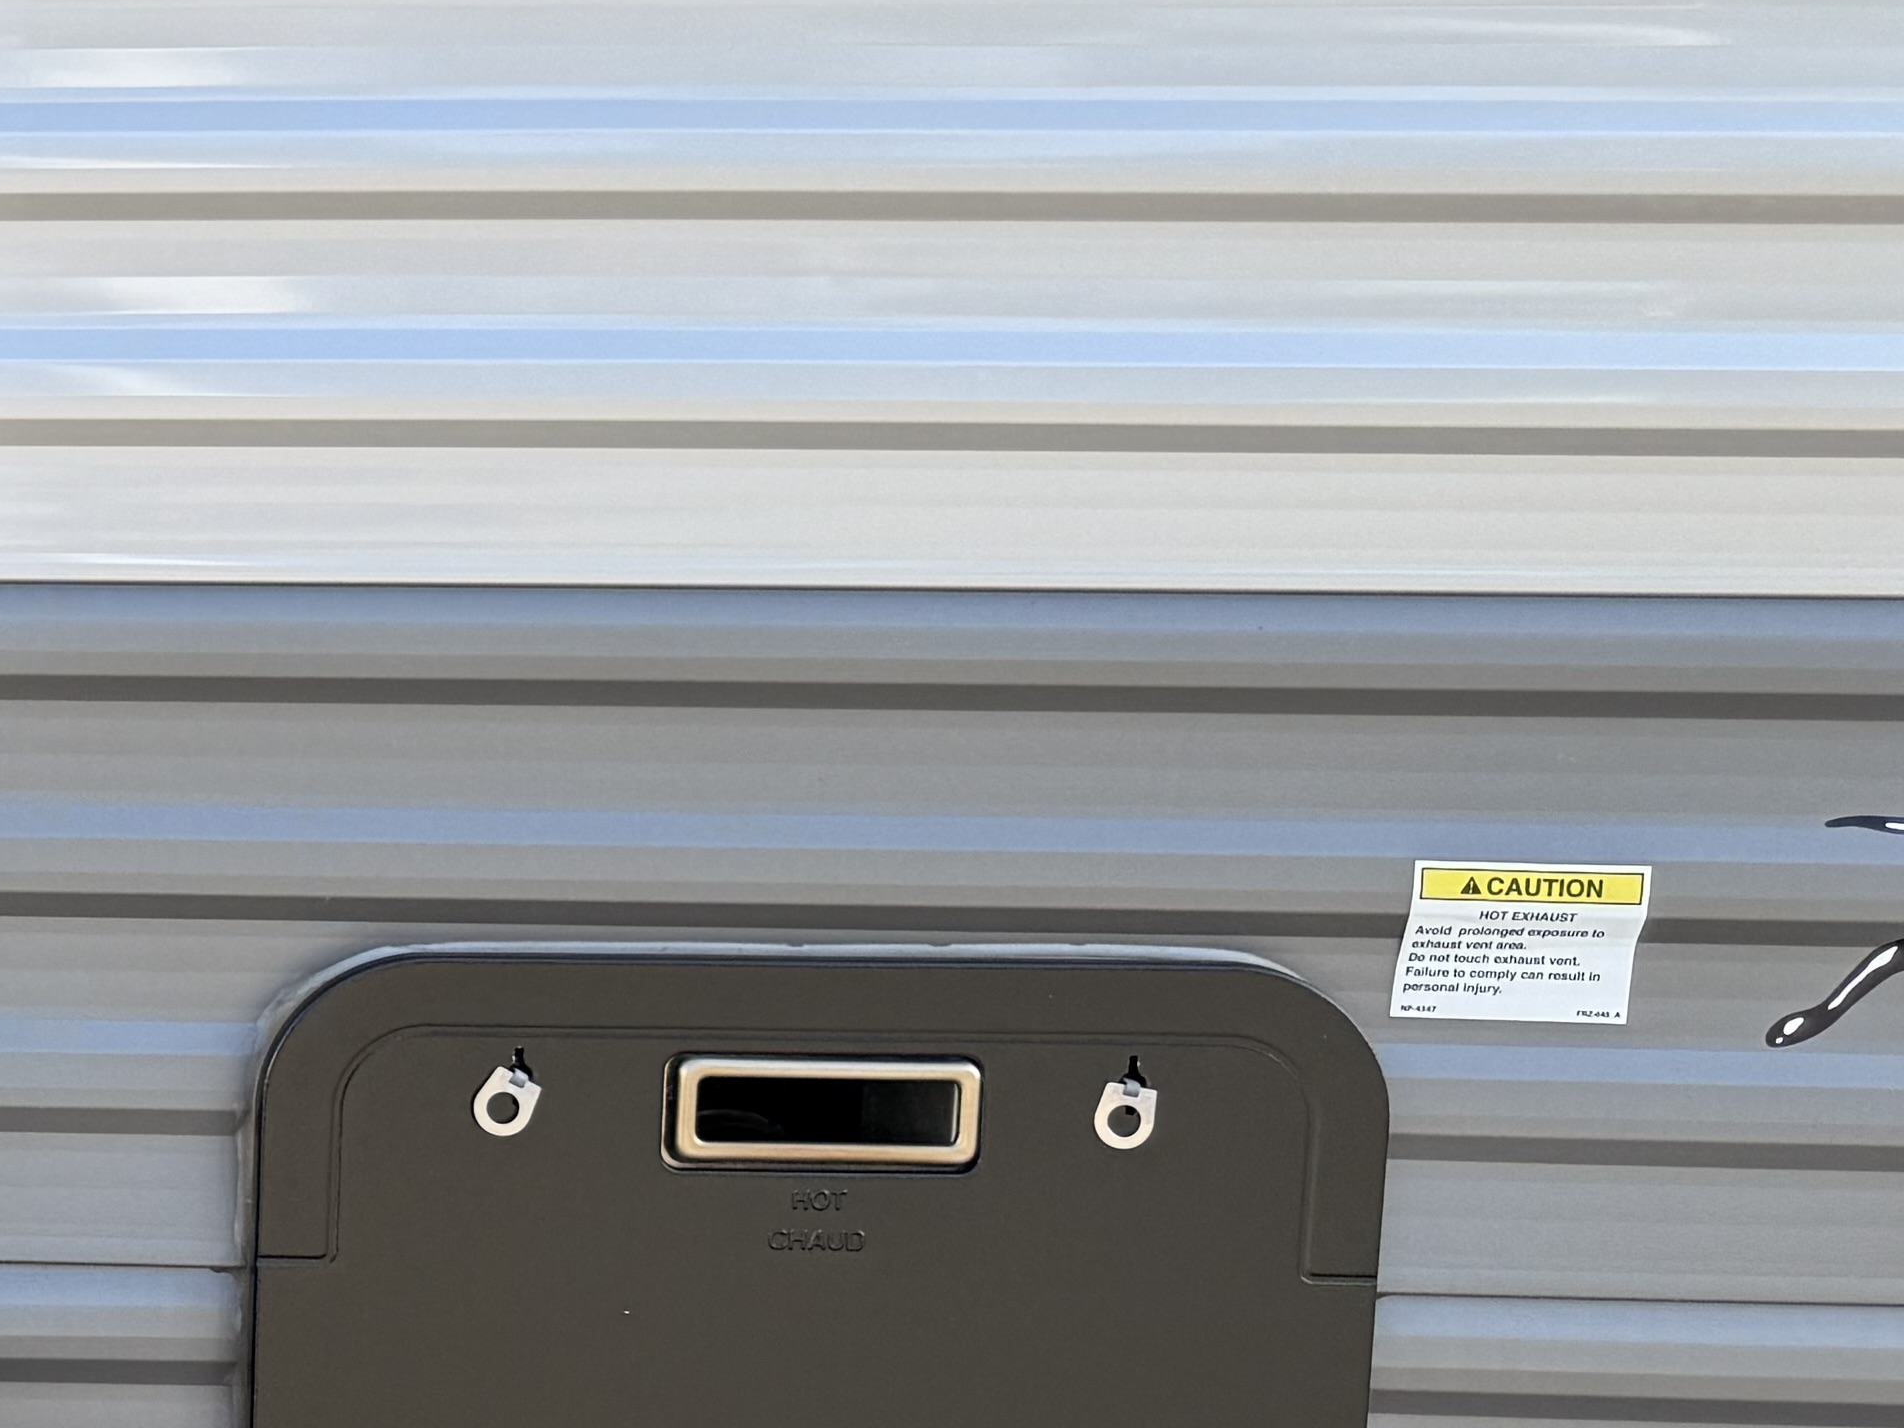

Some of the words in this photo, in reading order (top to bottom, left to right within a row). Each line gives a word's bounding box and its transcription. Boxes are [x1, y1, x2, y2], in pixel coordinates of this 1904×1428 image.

[1487, 877, 1604, 898] CAUTION
[1479, 910, 1508, 921] HOT
[1512, 911, 1578, 923] EXHAUST
[1415, 925, 1452, 936] Avoid
[1458, 927, 1524, 939] prolonged
[1528, 929, 1588, 940] exposure
[1592, 928, 1605, 938] to
[1412, 939, 1462, 950] exhaust
[1465, 940, 1493, 950] vent
[1496, 941, 1527, 951] area.
[1408, 952, 1425, 963] Do
[1429, 953, 1450, 963] not
[1454, 953, 1489, 964] touch
[1494, 954, 1545, 966] exhaust
[1549, 956, 1580, 967] vent.
[1405, 966, 1449, 977] Failure
[1453, 967, 1466, 978] to
[1469, 968, 1517, 981] comply
[1521, 971, 1544, 981] can
[1548, 971, 1586, 982] result
[1589, 971, 1600, 982] in
[1403, 982, 1459, 993] personal
[1463, 983, 1502, 995] injury.
[791, 1189, 848, 1211] HOT
[768, 1230, 865, 1252] CHAUD
